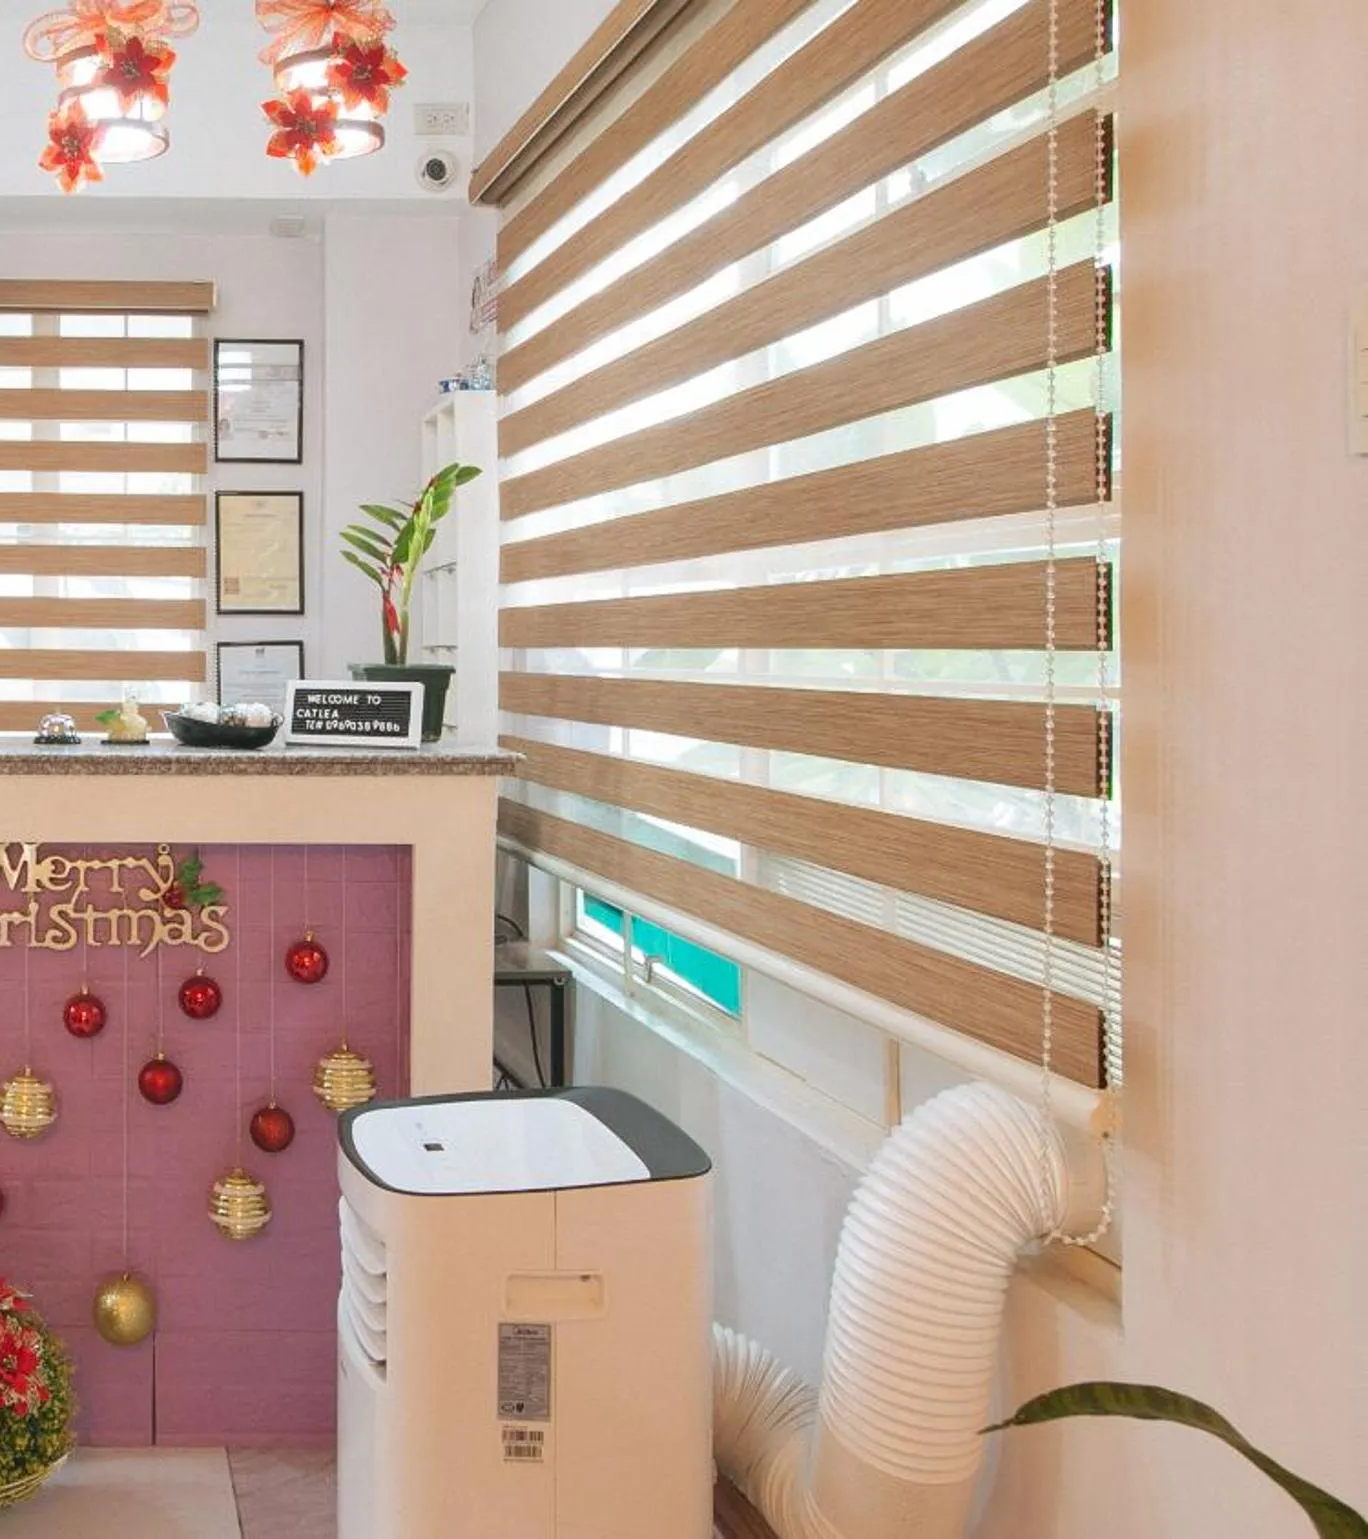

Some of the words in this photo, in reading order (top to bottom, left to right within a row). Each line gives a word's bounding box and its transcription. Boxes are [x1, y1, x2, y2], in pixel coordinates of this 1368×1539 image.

[307, 694, 359, 706] WELCOME
[367, 694, 382, 706] TO
[295, 708, 340, 719] CATLEA
